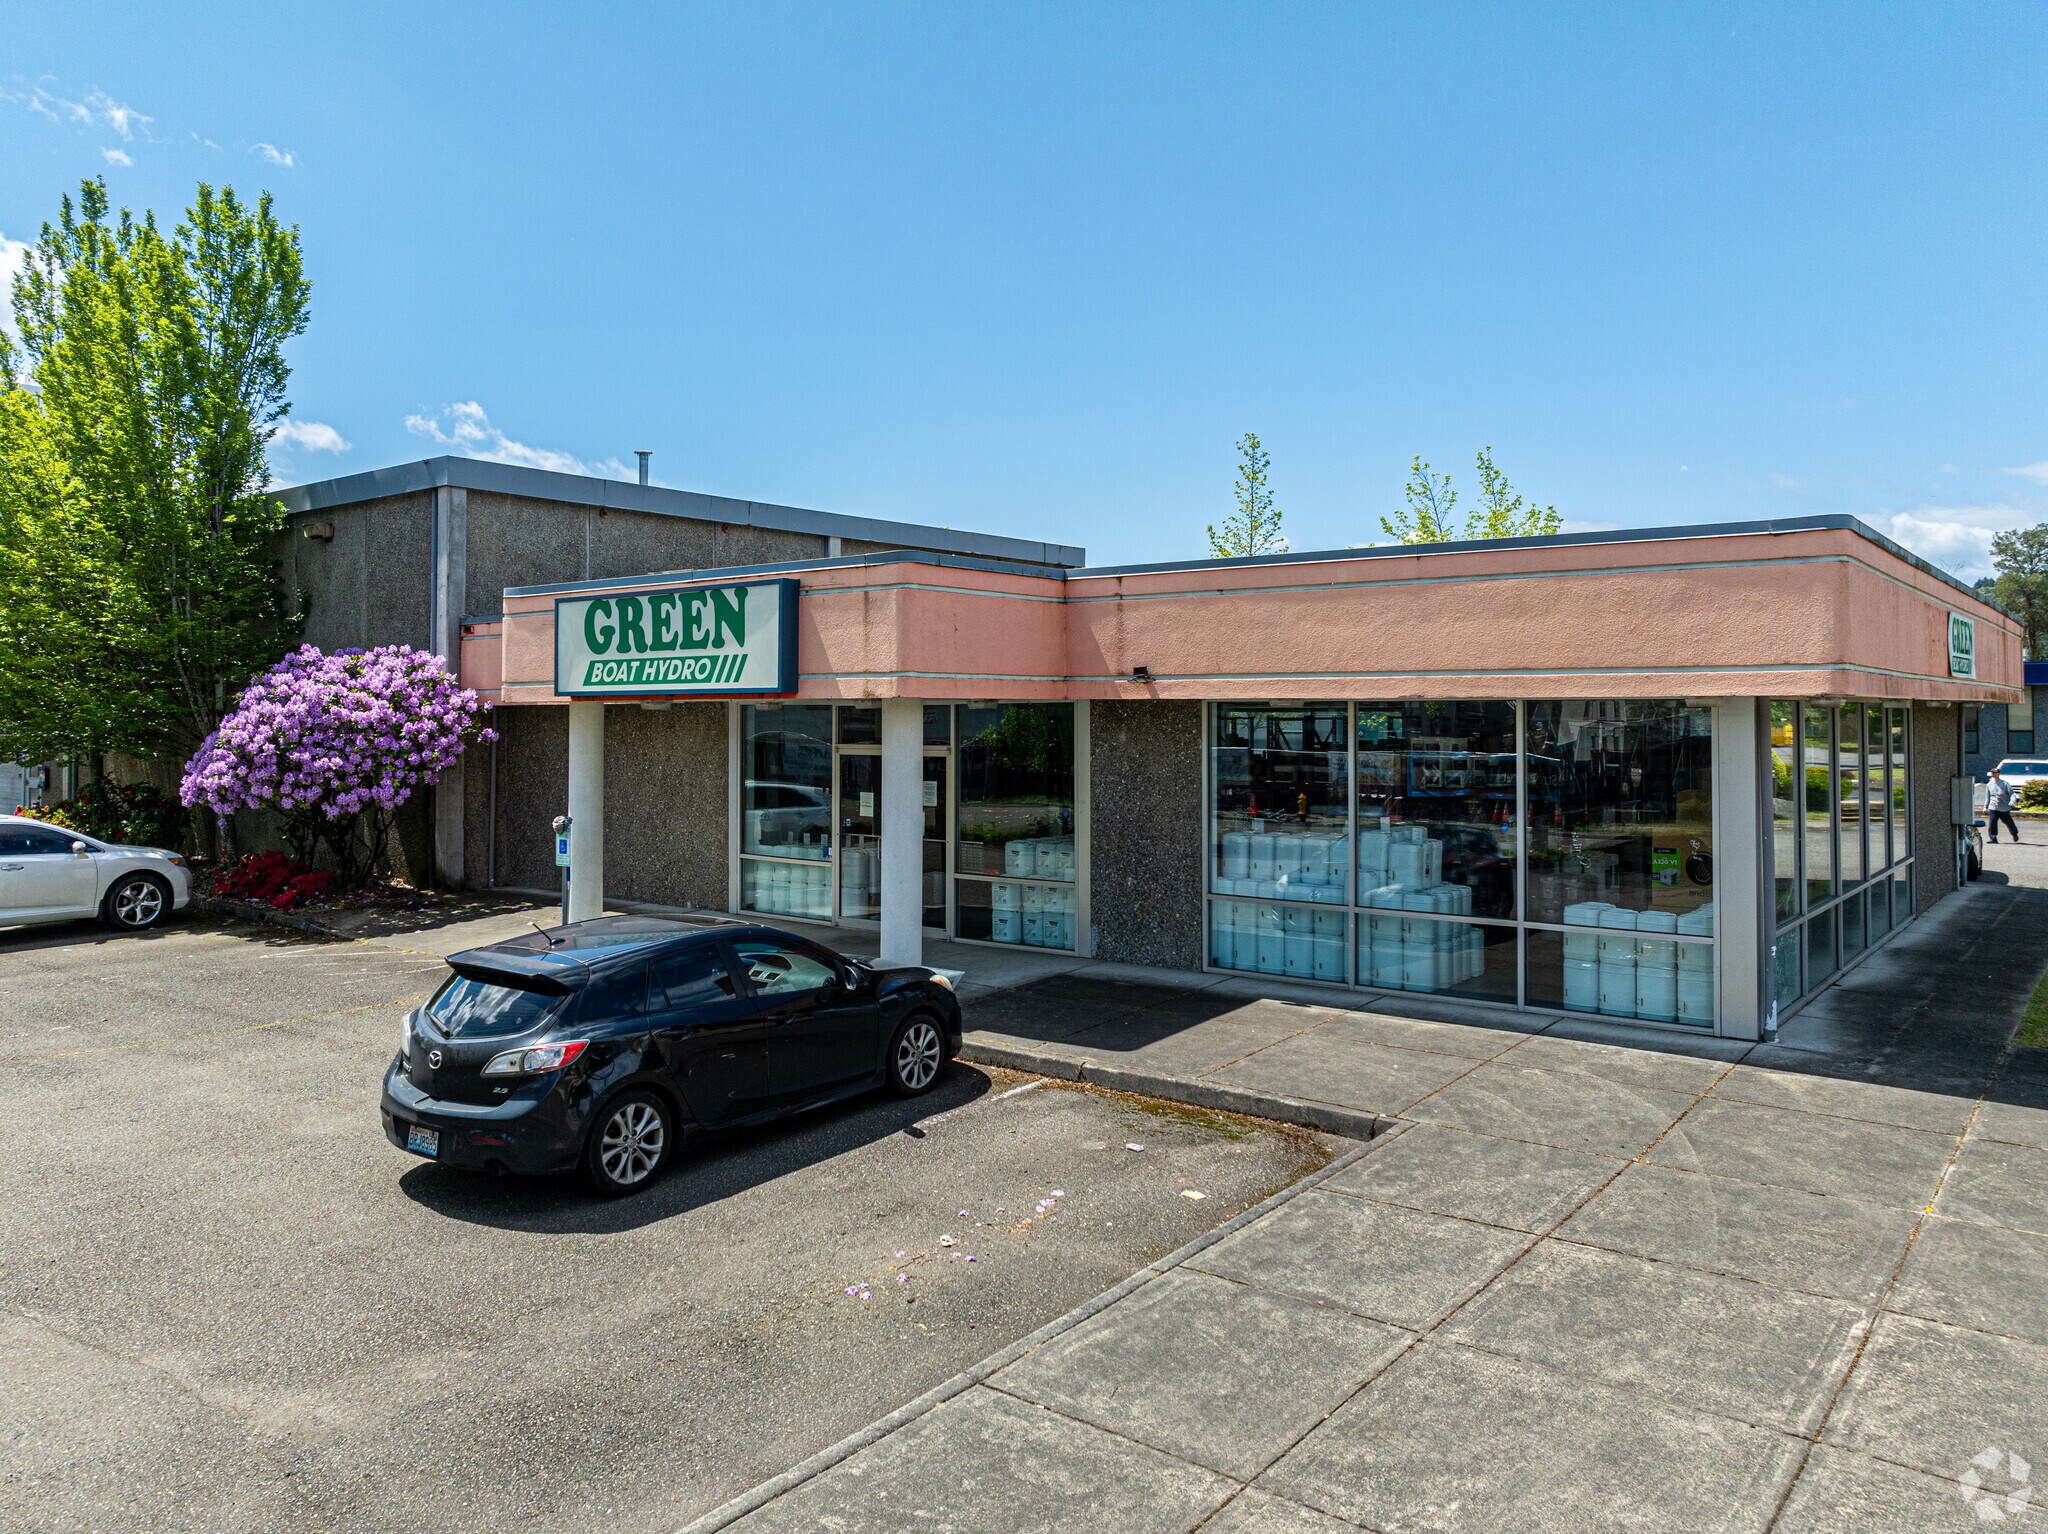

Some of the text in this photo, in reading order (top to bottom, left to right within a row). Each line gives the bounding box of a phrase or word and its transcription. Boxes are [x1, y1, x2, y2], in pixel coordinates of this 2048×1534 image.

[584, 587, 748, 655] GREEN
[591, 657, 711, 683] BOAT HYDRO
